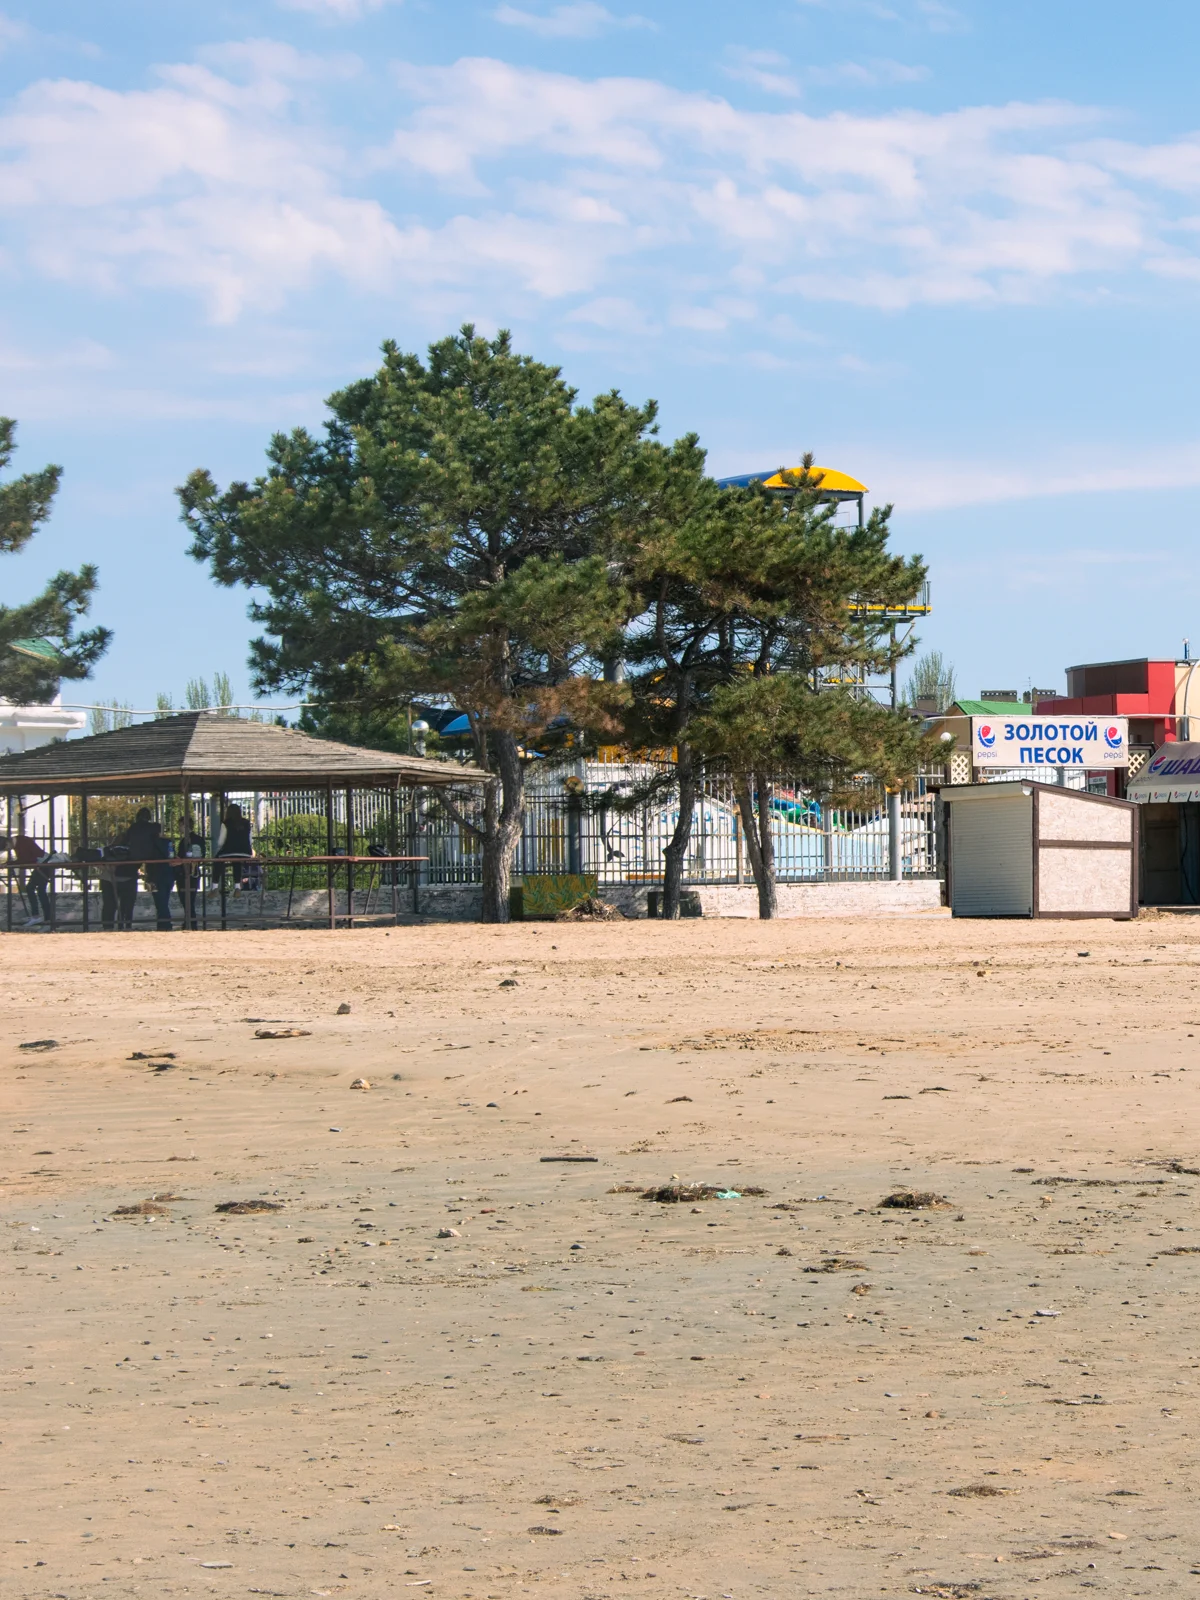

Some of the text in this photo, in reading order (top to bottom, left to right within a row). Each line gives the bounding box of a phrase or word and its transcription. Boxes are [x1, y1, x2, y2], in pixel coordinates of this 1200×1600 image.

[1004, 721, 1098, 741] ЗОЛОТОЙ
[977, 751, 998, 759] pepsi
[1020, 747, 1084, 763] ПЕСОК
[1103, 751, 1124, 759] pepsi
